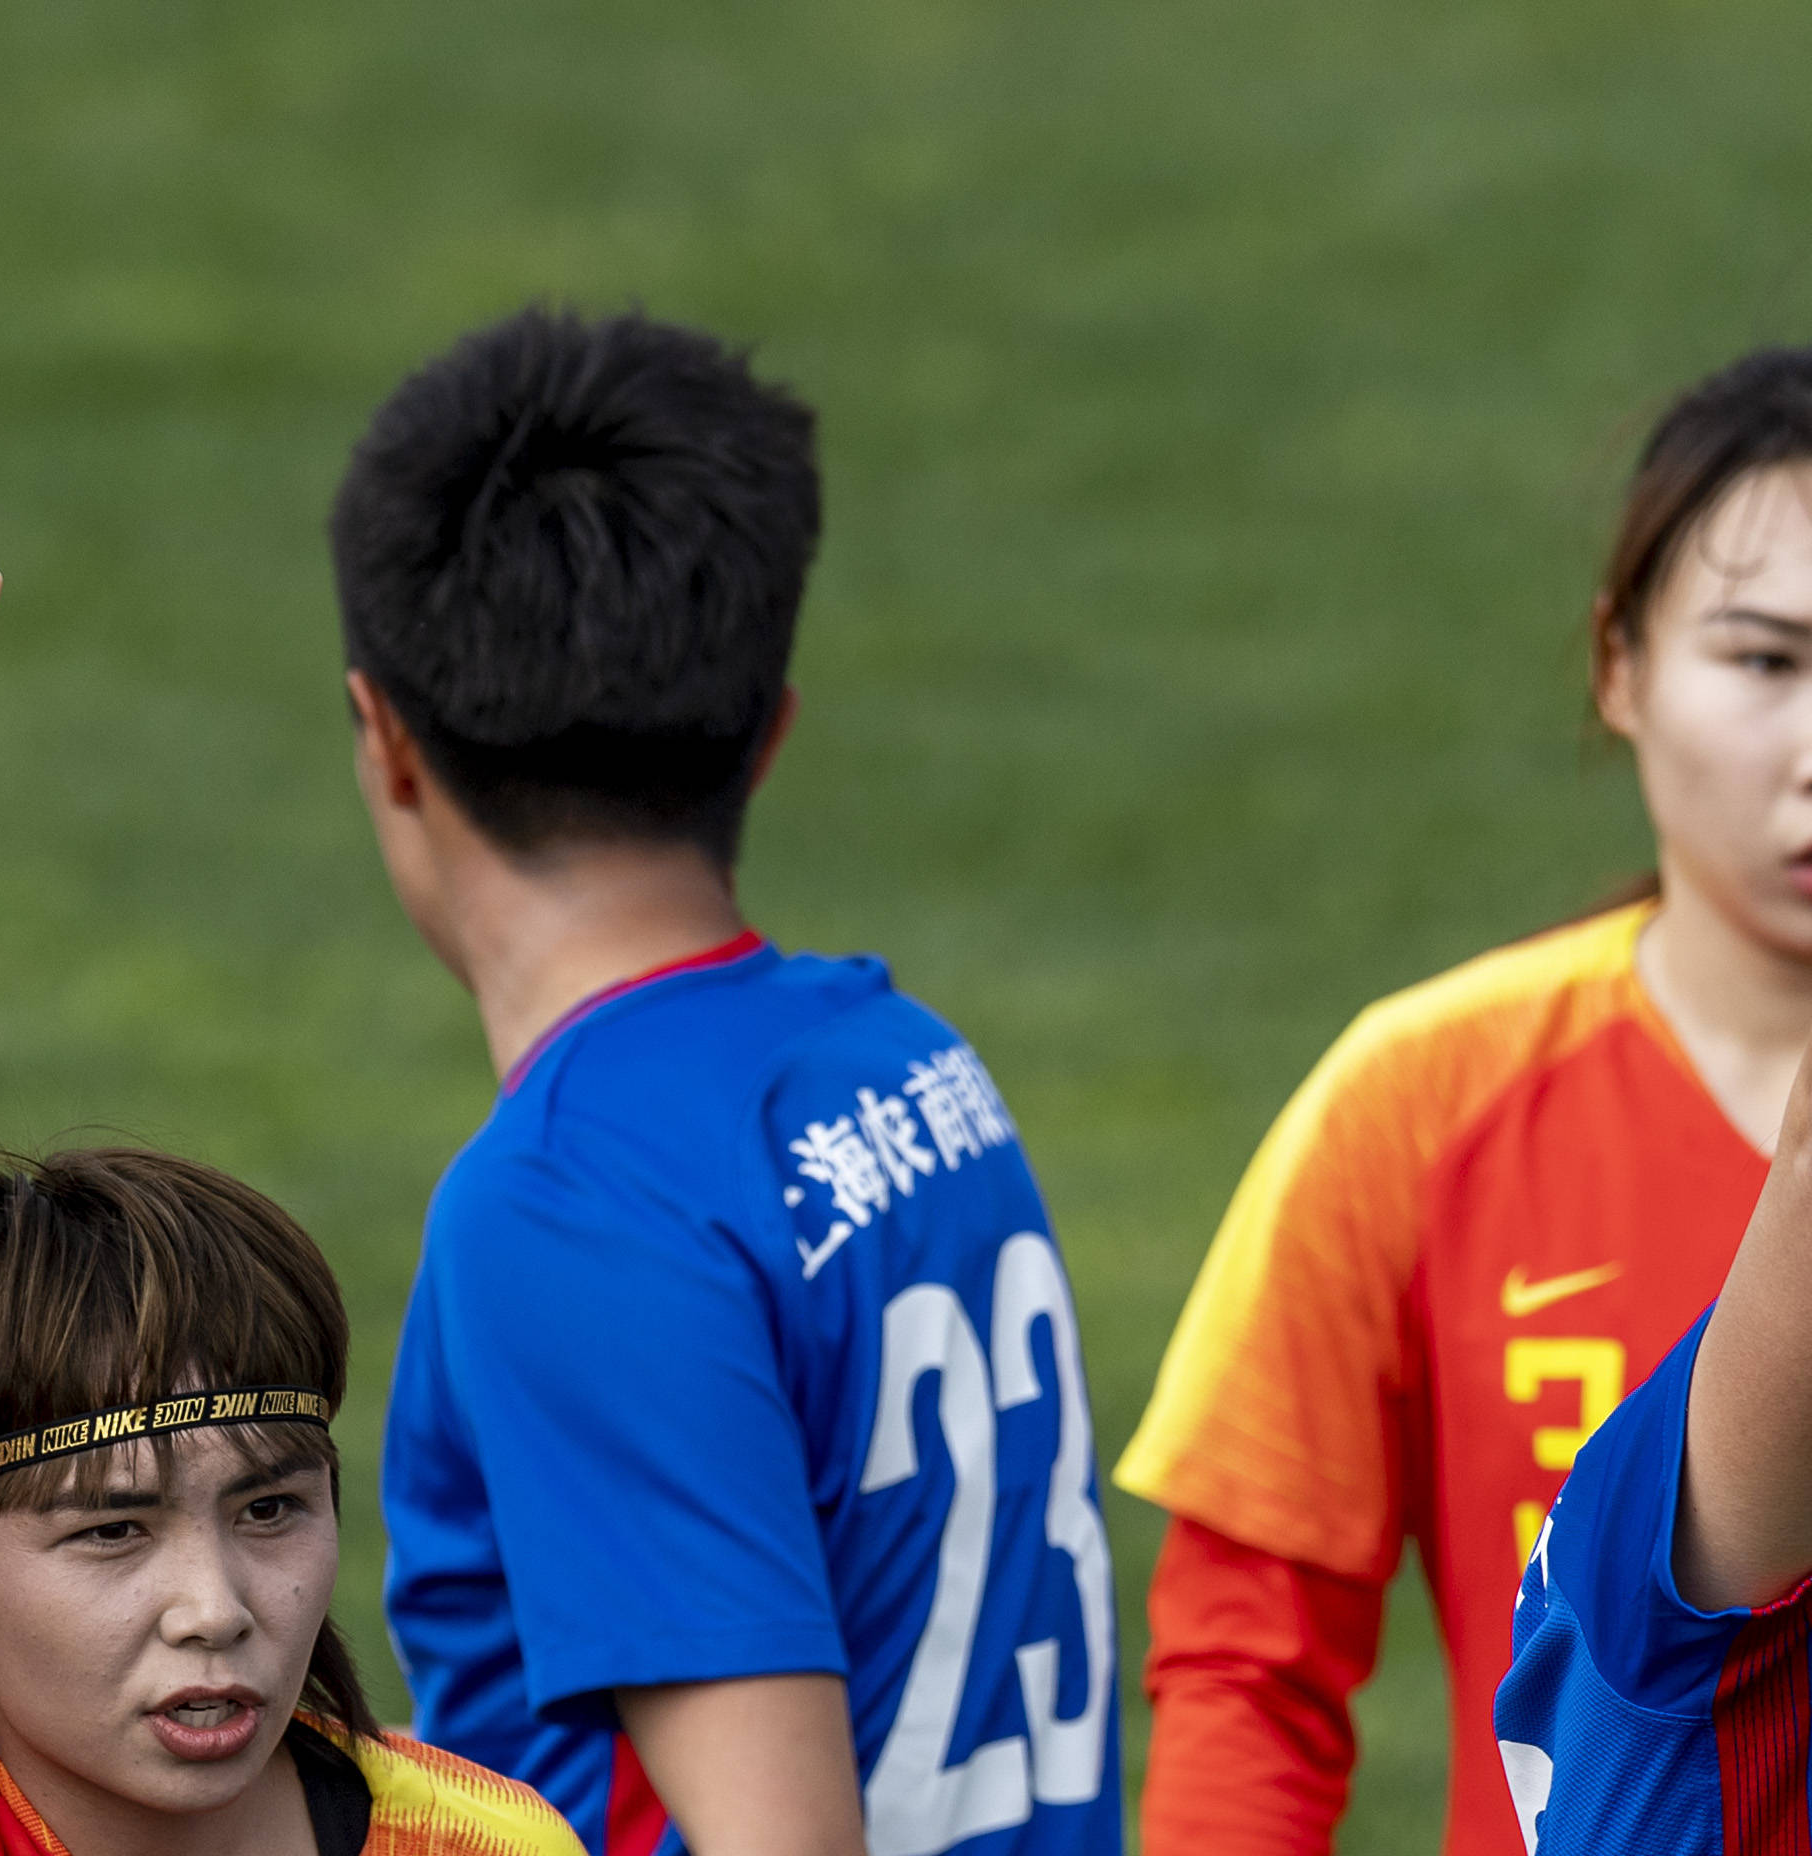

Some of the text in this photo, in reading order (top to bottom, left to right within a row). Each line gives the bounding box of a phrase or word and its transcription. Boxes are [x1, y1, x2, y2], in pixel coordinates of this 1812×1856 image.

[42, 1419, 89, 1453] NIKE
[93, 1406, 147, 1440] NIKE
[210, 1393, 258, 1419] NIKE
[260, 1391, 295, 1415] NIKE
